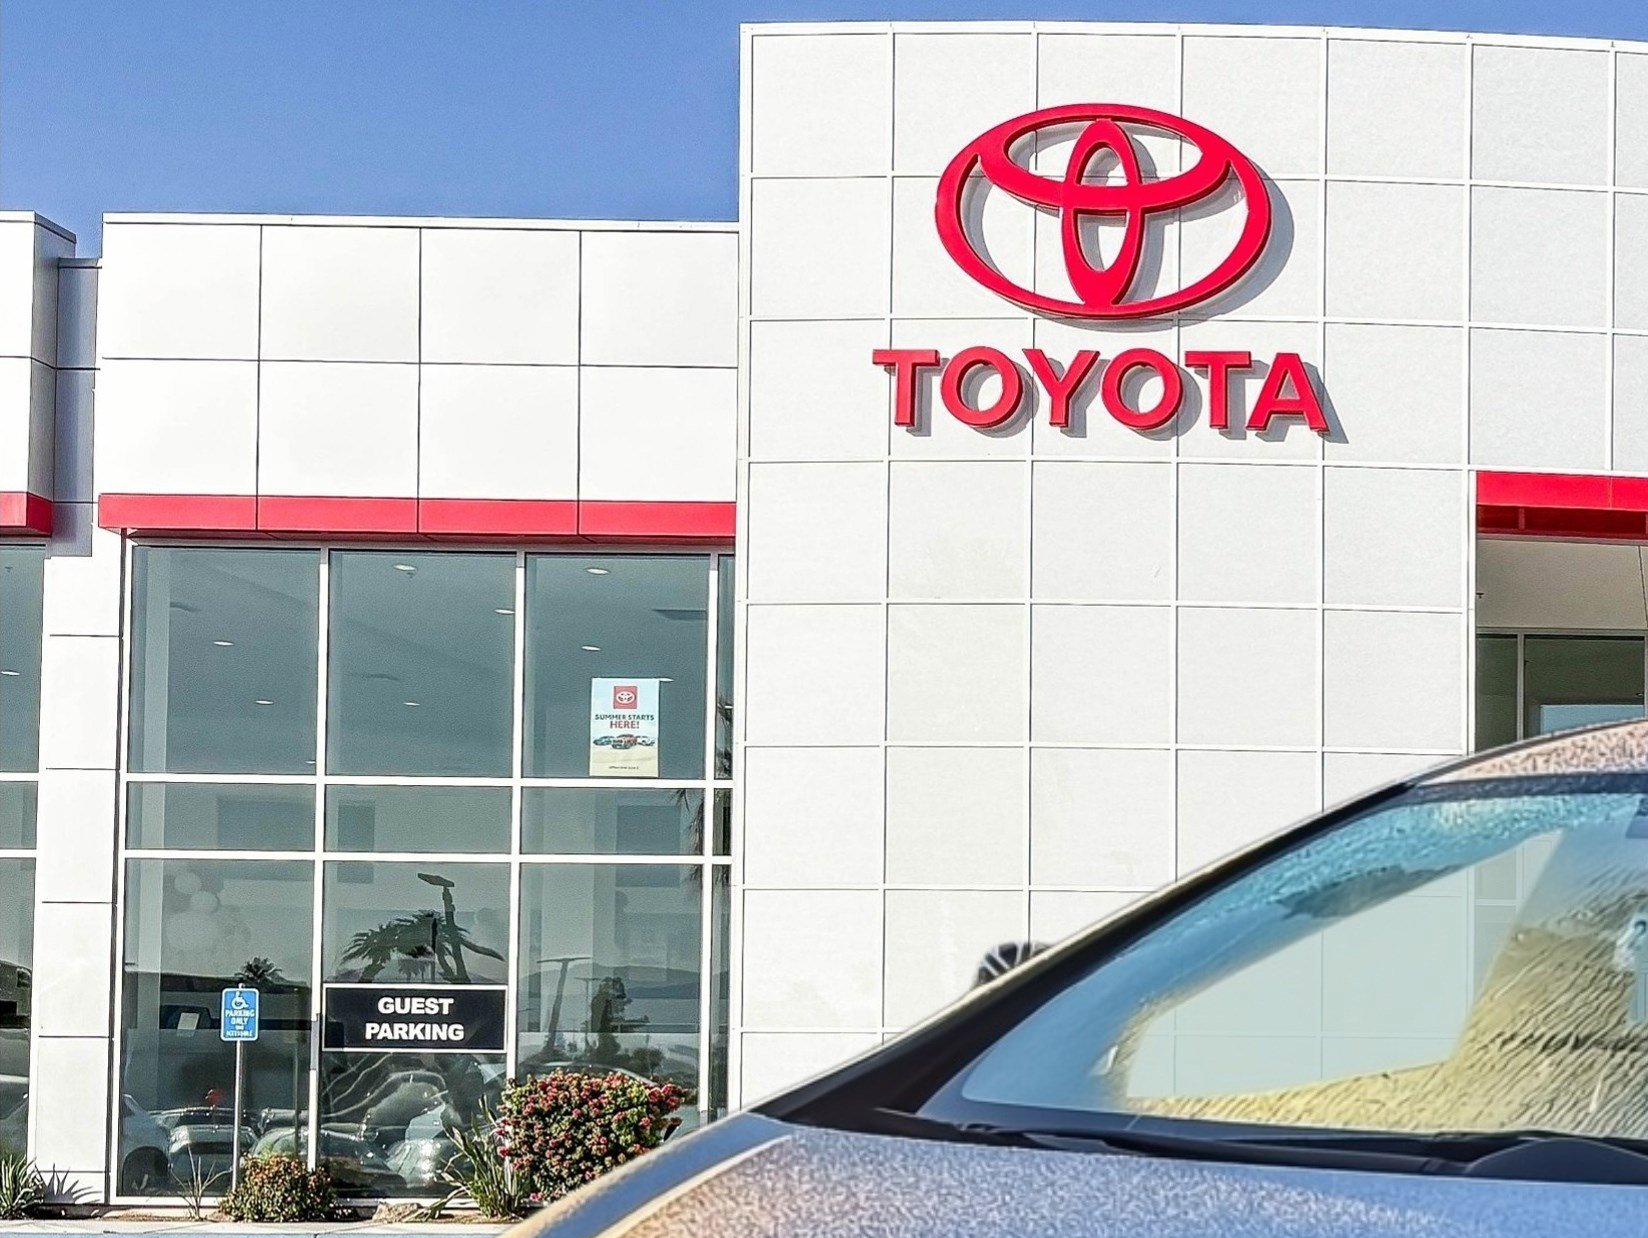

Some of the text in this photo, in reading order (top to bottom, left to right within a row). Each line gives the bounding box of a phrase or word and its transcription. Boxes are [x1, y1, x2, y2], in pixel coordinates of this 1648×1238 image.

[872, 345, 1329, 433] TOYOTA
[609, 720, 640, 729] HERE!
[377, 996, 455, 1015] GUEST
[225, 1009, 255, 1017] PARKING
[230, 1017, 249, 1025] ONLY
[365, 1022, 465, 1041] PARKING
